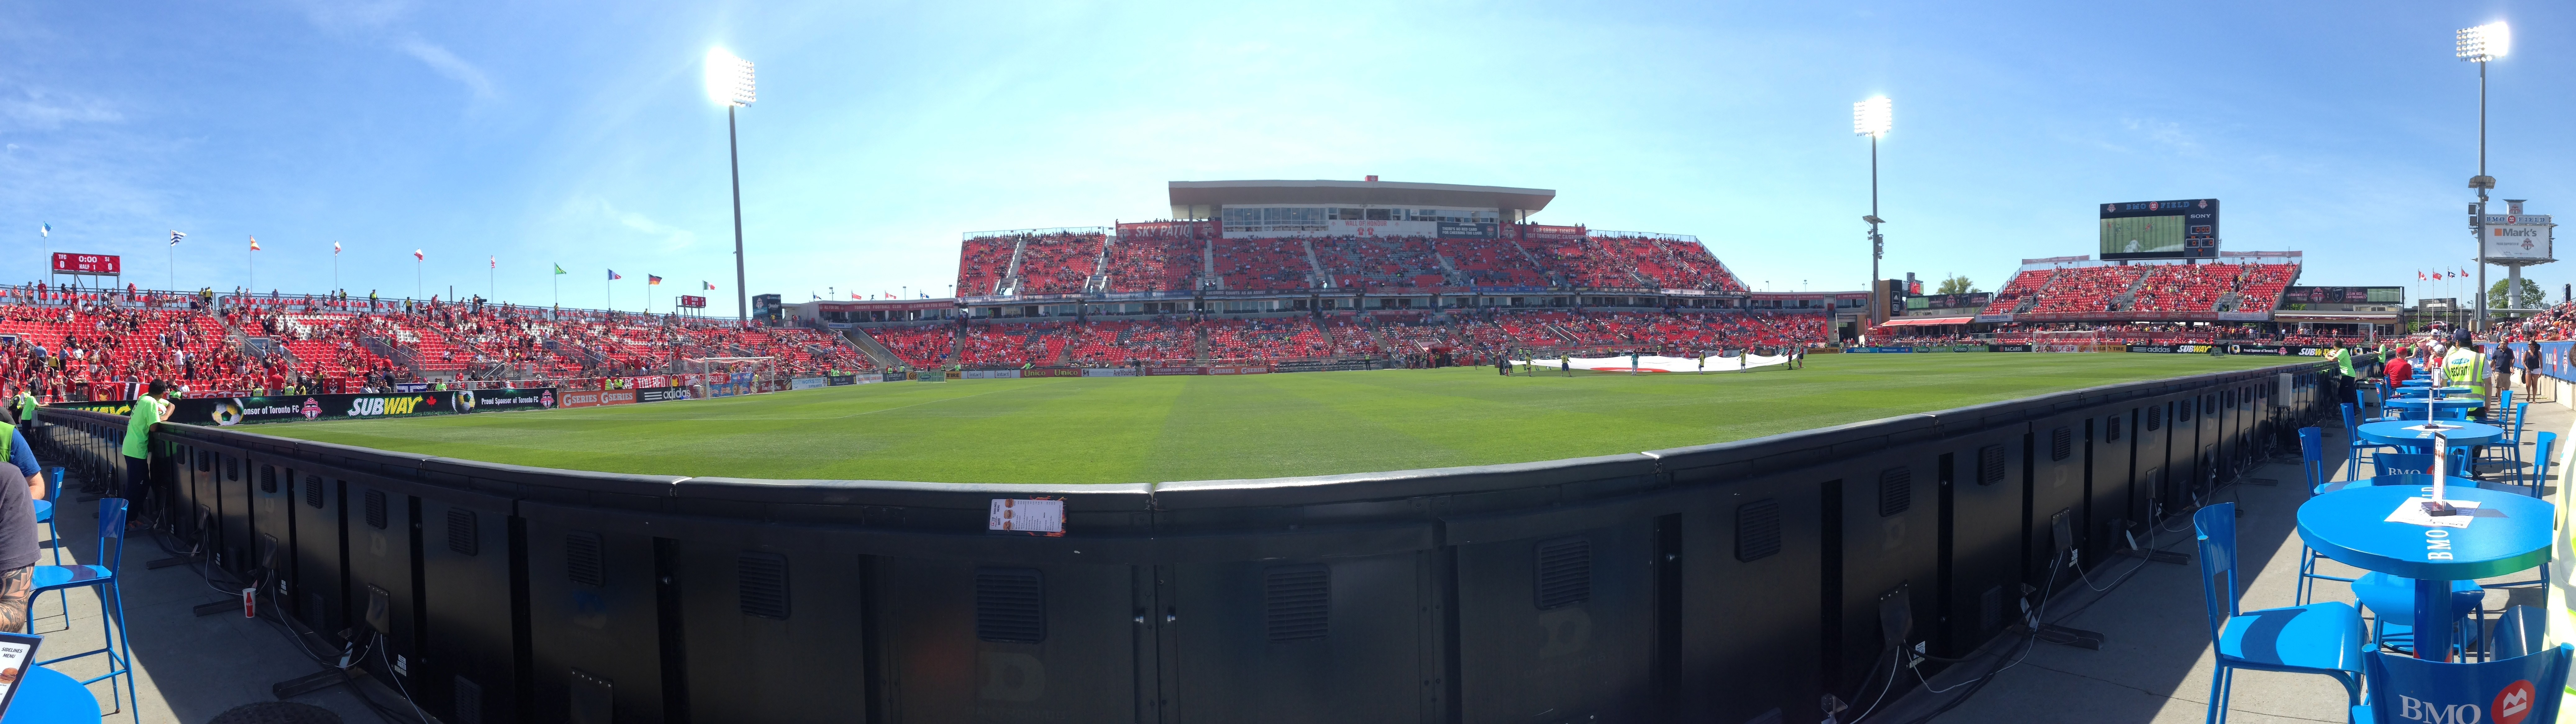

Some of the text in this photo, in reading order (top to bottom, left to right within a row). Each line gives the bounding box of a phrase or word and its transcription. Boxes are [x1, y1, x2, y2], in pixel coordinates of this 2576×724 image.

[1135, 225, 1157, 237] SKY
[2503, 228, 2537, 237] Mark's
[2451, 366, 2470, 377] SECURITY
[609, 393, 633, 401] SERIES
[663, 388, 691, 399] adidas
[495, 397, 511, 406] Sponsor
[572, 395, 597, 404] SERIES
[262, 405, 299, 414] of Toronto FC
[347, 395, 423, 417] SUBWAY
[2425, 529, 2453, 560] BMO
[2399, 695, 2481, 724] BMO
